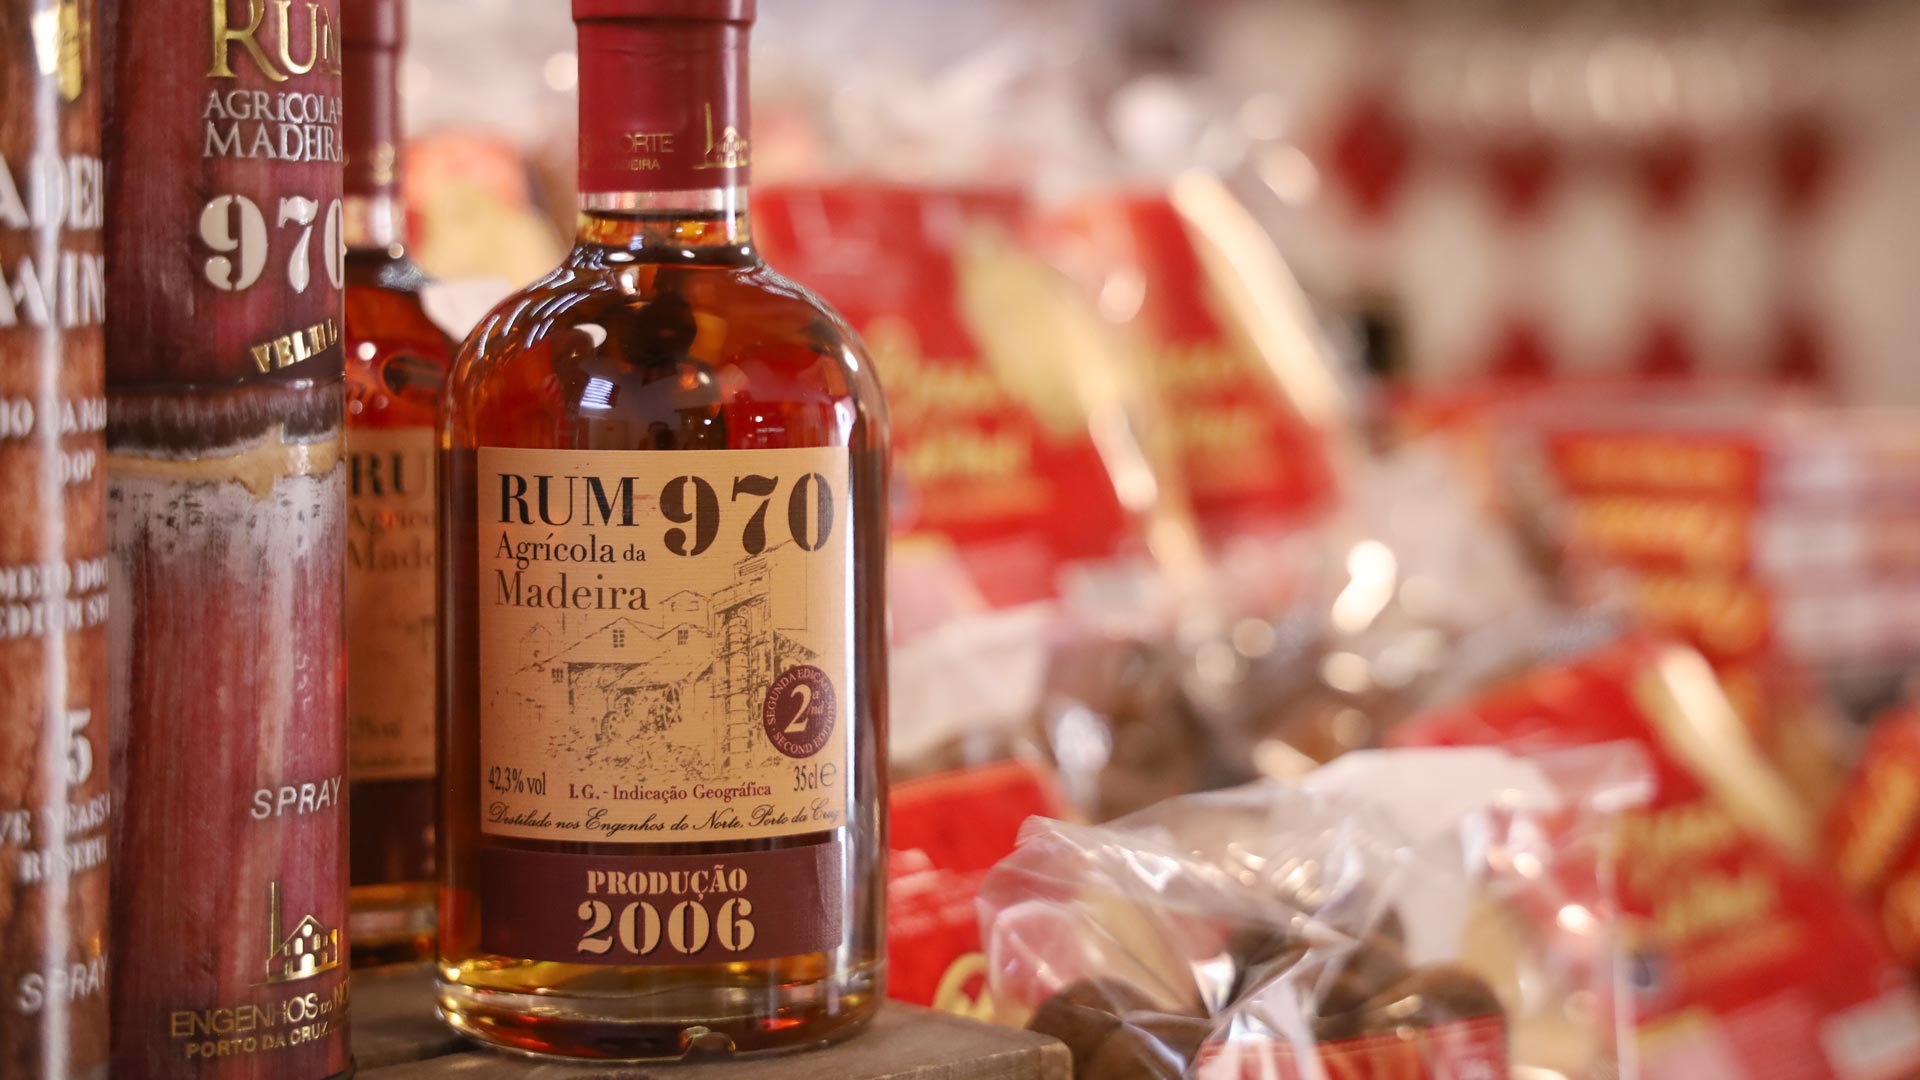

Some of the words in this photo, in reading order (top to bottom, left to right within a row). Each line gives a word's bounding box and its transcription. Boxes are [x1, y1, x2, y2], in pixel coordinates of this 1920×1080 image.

[200, 194, 344, 291] 970
[497, 473, 640, 527] RUM
[659, 472, 835, 557] 970
[495, 531, 616, 570] Agrícola
[622, 543, 647, 562] da
[495, 569, 650, 611] Madeira
[766, 673, 796, 725] SEGUNDA
[773, 732, 812, 754] SECOND
[251, 776, 342, 820] SPRAY
[488, 766, 524, 795] 42,3%
[527, 772, 547, 795] vol
[613, 784, 688, 804] Indicação
[693, 781, 772, 803] Geográfica
[488, 801, 552, 828] Destilado
[556, 821, 580, 829] nos
[585, 807, 665, 837] Engenhos
[670, 815, 689, 831] do
[748, 804, 788, 827] Porto
[791, 806, 808, 823] da
[587, 864, 748, 901] PRODUÇÃO
[577, 897, 756, 956] 2006
[171, 991, 319, 1039] ENGENHOS
[186, 1036, 257, 1059] PORTO
[262, 1032, 286, 1051] DA
